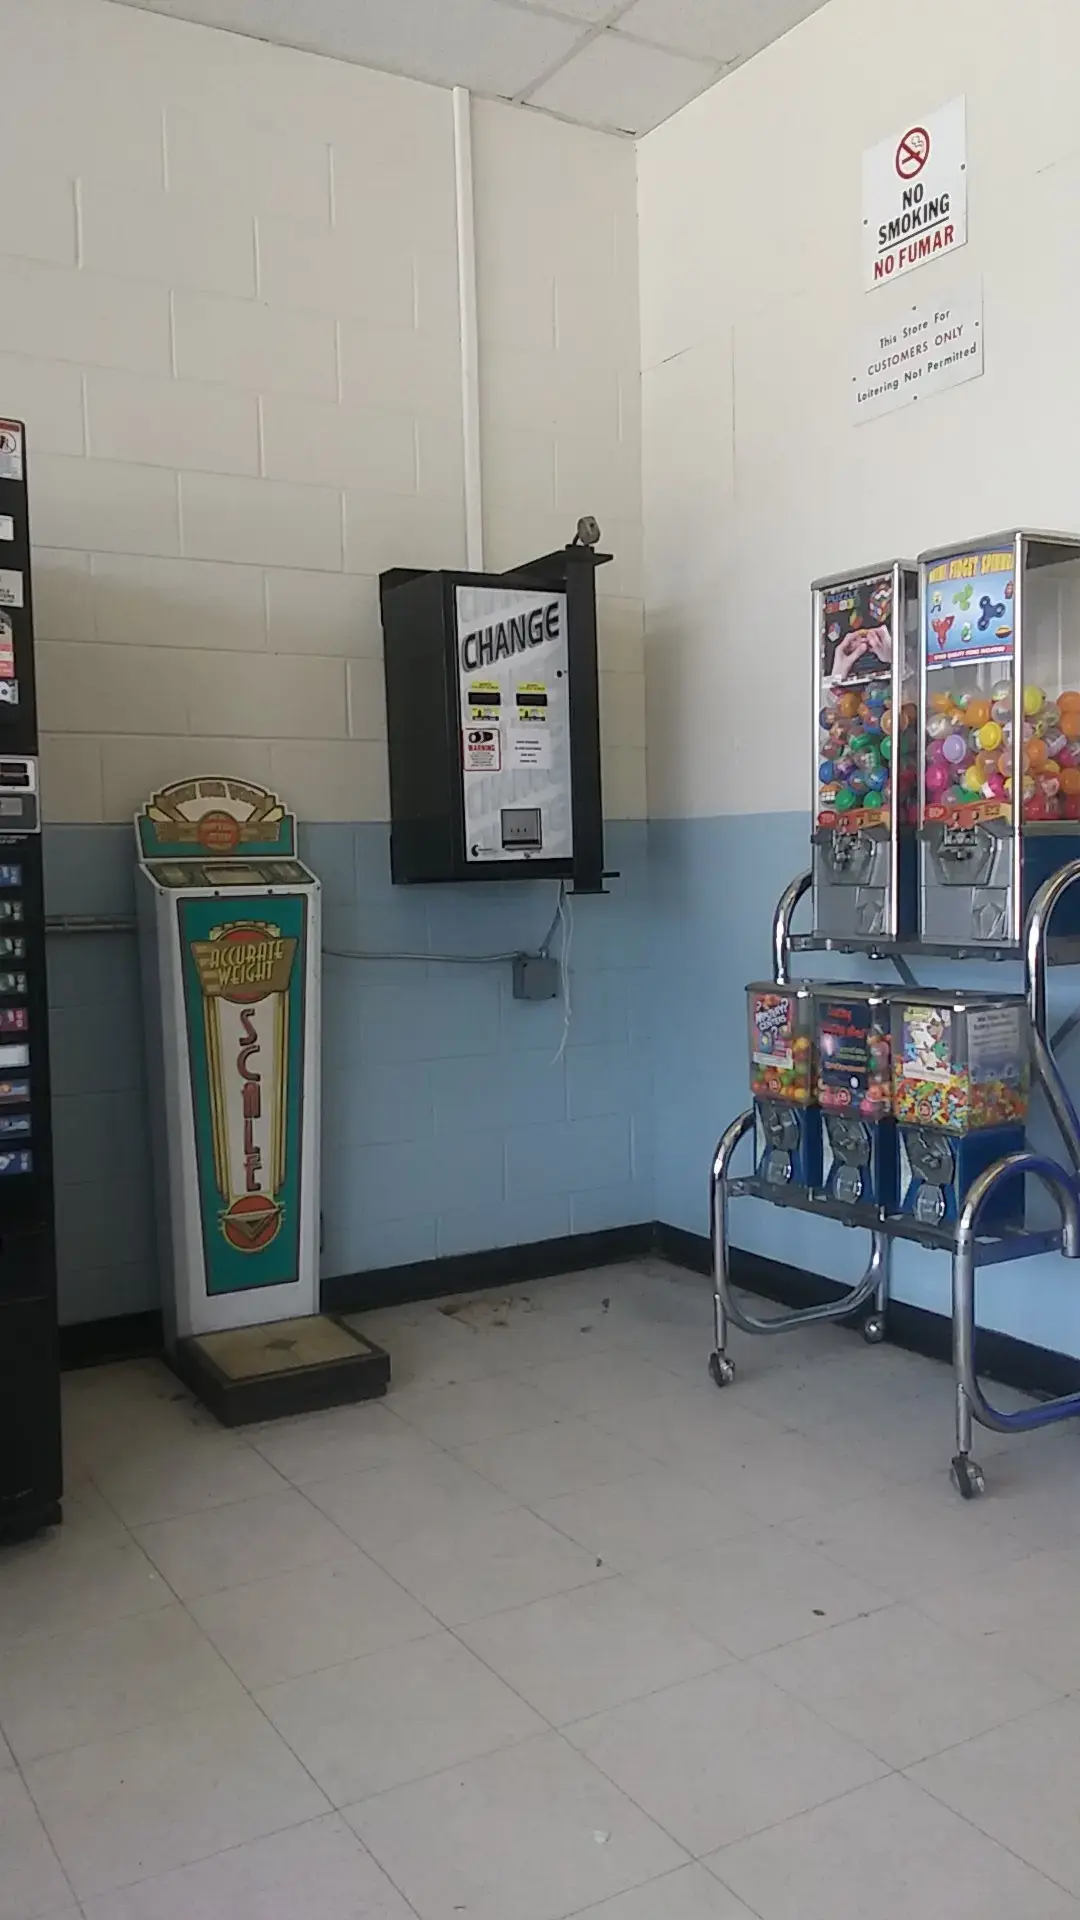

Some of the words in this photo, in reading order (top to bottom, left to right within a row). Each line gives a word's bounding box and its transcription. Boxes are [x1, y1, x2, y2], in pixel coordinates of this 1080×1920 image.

[878, 193, 950, 246] SMOKING
[902, 183, 924, 211] NO
[873, 254, 895, 280] NO
[898, 224, 954, 268] FUMAR
[867, 341, 928, 376] CUSTOMERS
[934, 324, 963, 347] ONLY
[880, 334, 897, 349] This
[902, 320, 929, 339] Store
[934, 310, 950, 324] For
[857, 379, 899, 403] Loitering
[904, 368, 922, 383] Not
[927, 341, 977, 373] Permitted
[461, 601, 560, 673] CHANGE
[210, 939, 285, 969] ACCURATE
[217, 960, 276, 986] WEIGHT
[236, 1008, 263, 1192] SCALE
